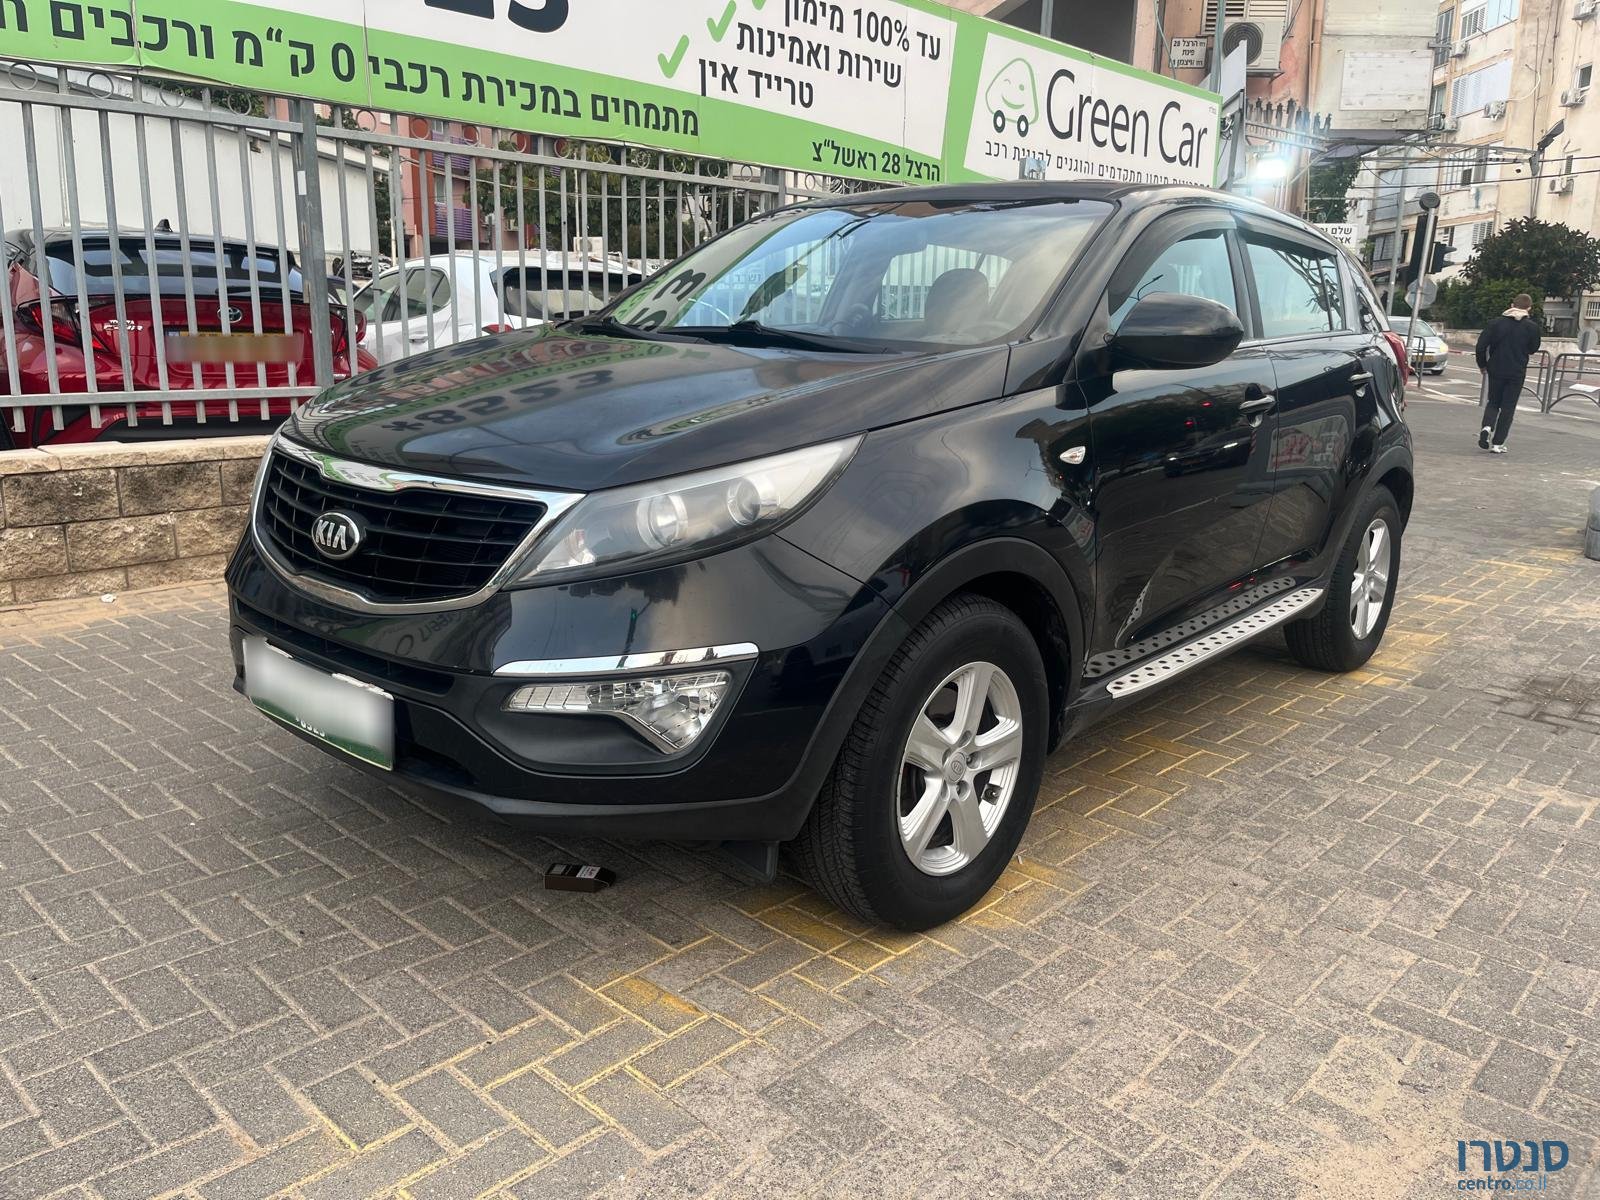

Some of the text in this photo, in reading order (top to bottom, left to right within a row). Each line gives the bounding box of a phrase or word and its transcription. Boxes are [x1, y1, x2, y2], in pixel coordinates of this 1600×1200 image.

[50, 2, 216, 60] ורכבים
[853, 8, 910, 52] 100%
[916, 31, 942, 61] עד
[736, 21, 902, 88] שירות ואמינות
[367, 55, 450, 98] רכבי
[461, 71, 582, 119] במכירת
[698, 57, 815, 108] טרייד אין
[590, 93, 699, 137] מתמחים
[1046, 68, 1208, 169] Green Car
[881, 151, 901, 175] 28
[905, 153, 941, 182] הרצל
[985, 140, 1008, 159] רכב
[1056, 155, 1095, 176] והוגנים
[315, 519, 348, 551] KIA
